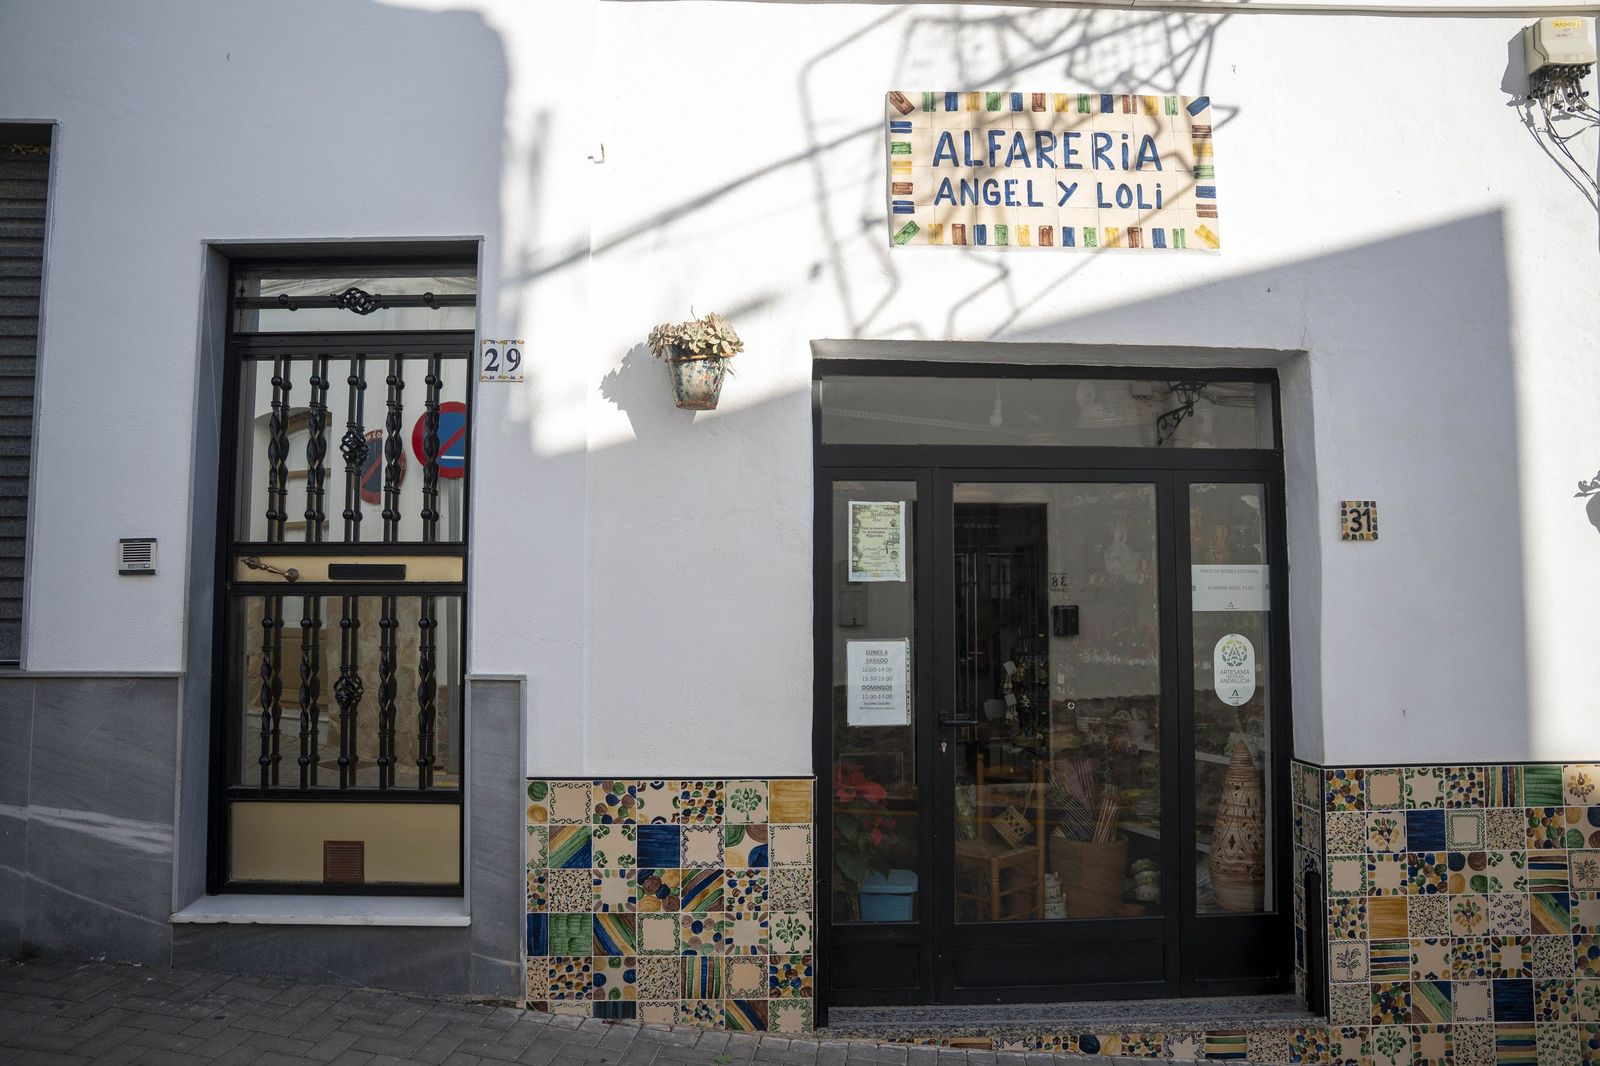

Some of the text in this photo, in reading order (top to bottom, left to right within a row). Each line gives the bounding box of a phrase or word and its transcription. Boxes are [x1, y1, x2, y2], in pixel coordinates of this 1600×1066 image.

[932, 130, 1162, 171] ALFARERiA
[933, 177, 1162, 209] ANGEL Y LOLi
[484, 348, 521, 372] 29
[1350, 508, 1371, 532] 31
